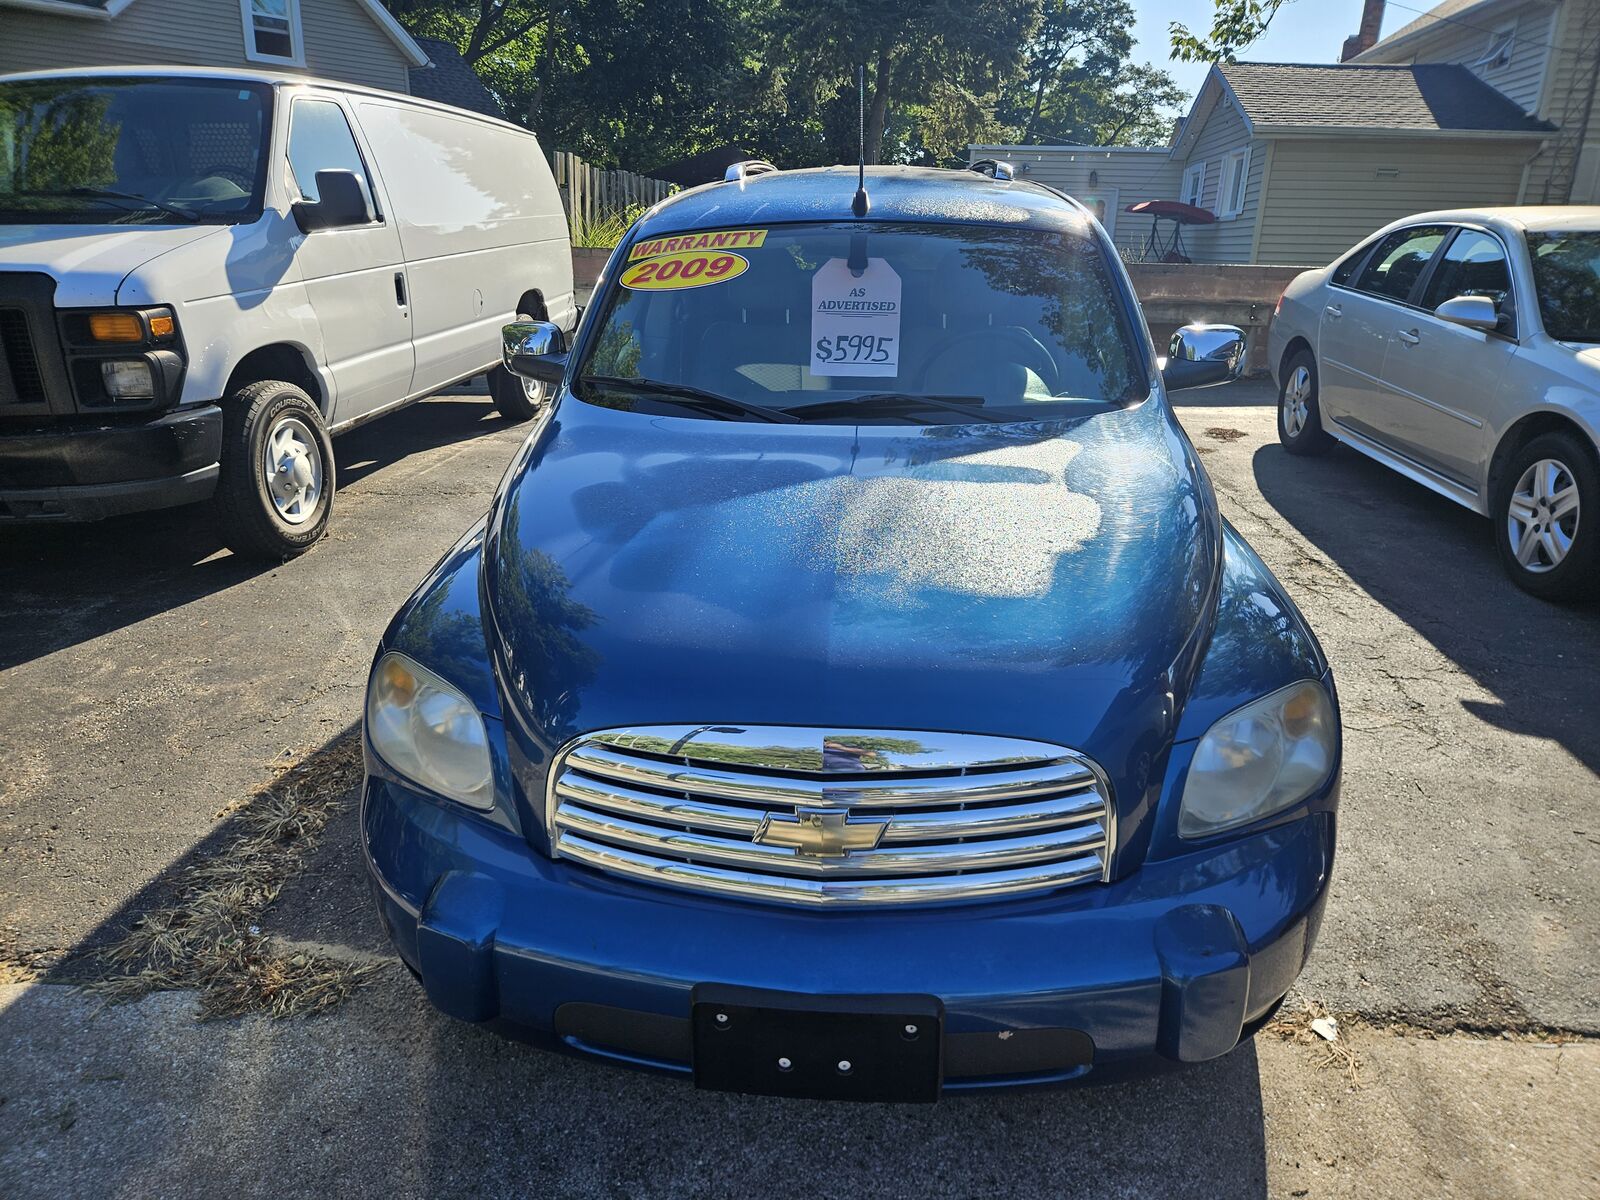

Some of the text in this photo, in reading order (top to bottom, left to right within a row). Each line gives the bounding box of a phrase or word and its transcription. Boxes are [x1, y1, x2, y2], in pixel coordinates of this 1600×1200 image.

[632, 231, 763, 258] WARRANTY
[628, 256, 735, 285] 2009
[849, 287, 866, 297] AS
[818, 300, 896, 311] ADVERTISED
[816, 335, 893, 362] $5995
[270, 398, 308, 418] COURSER
